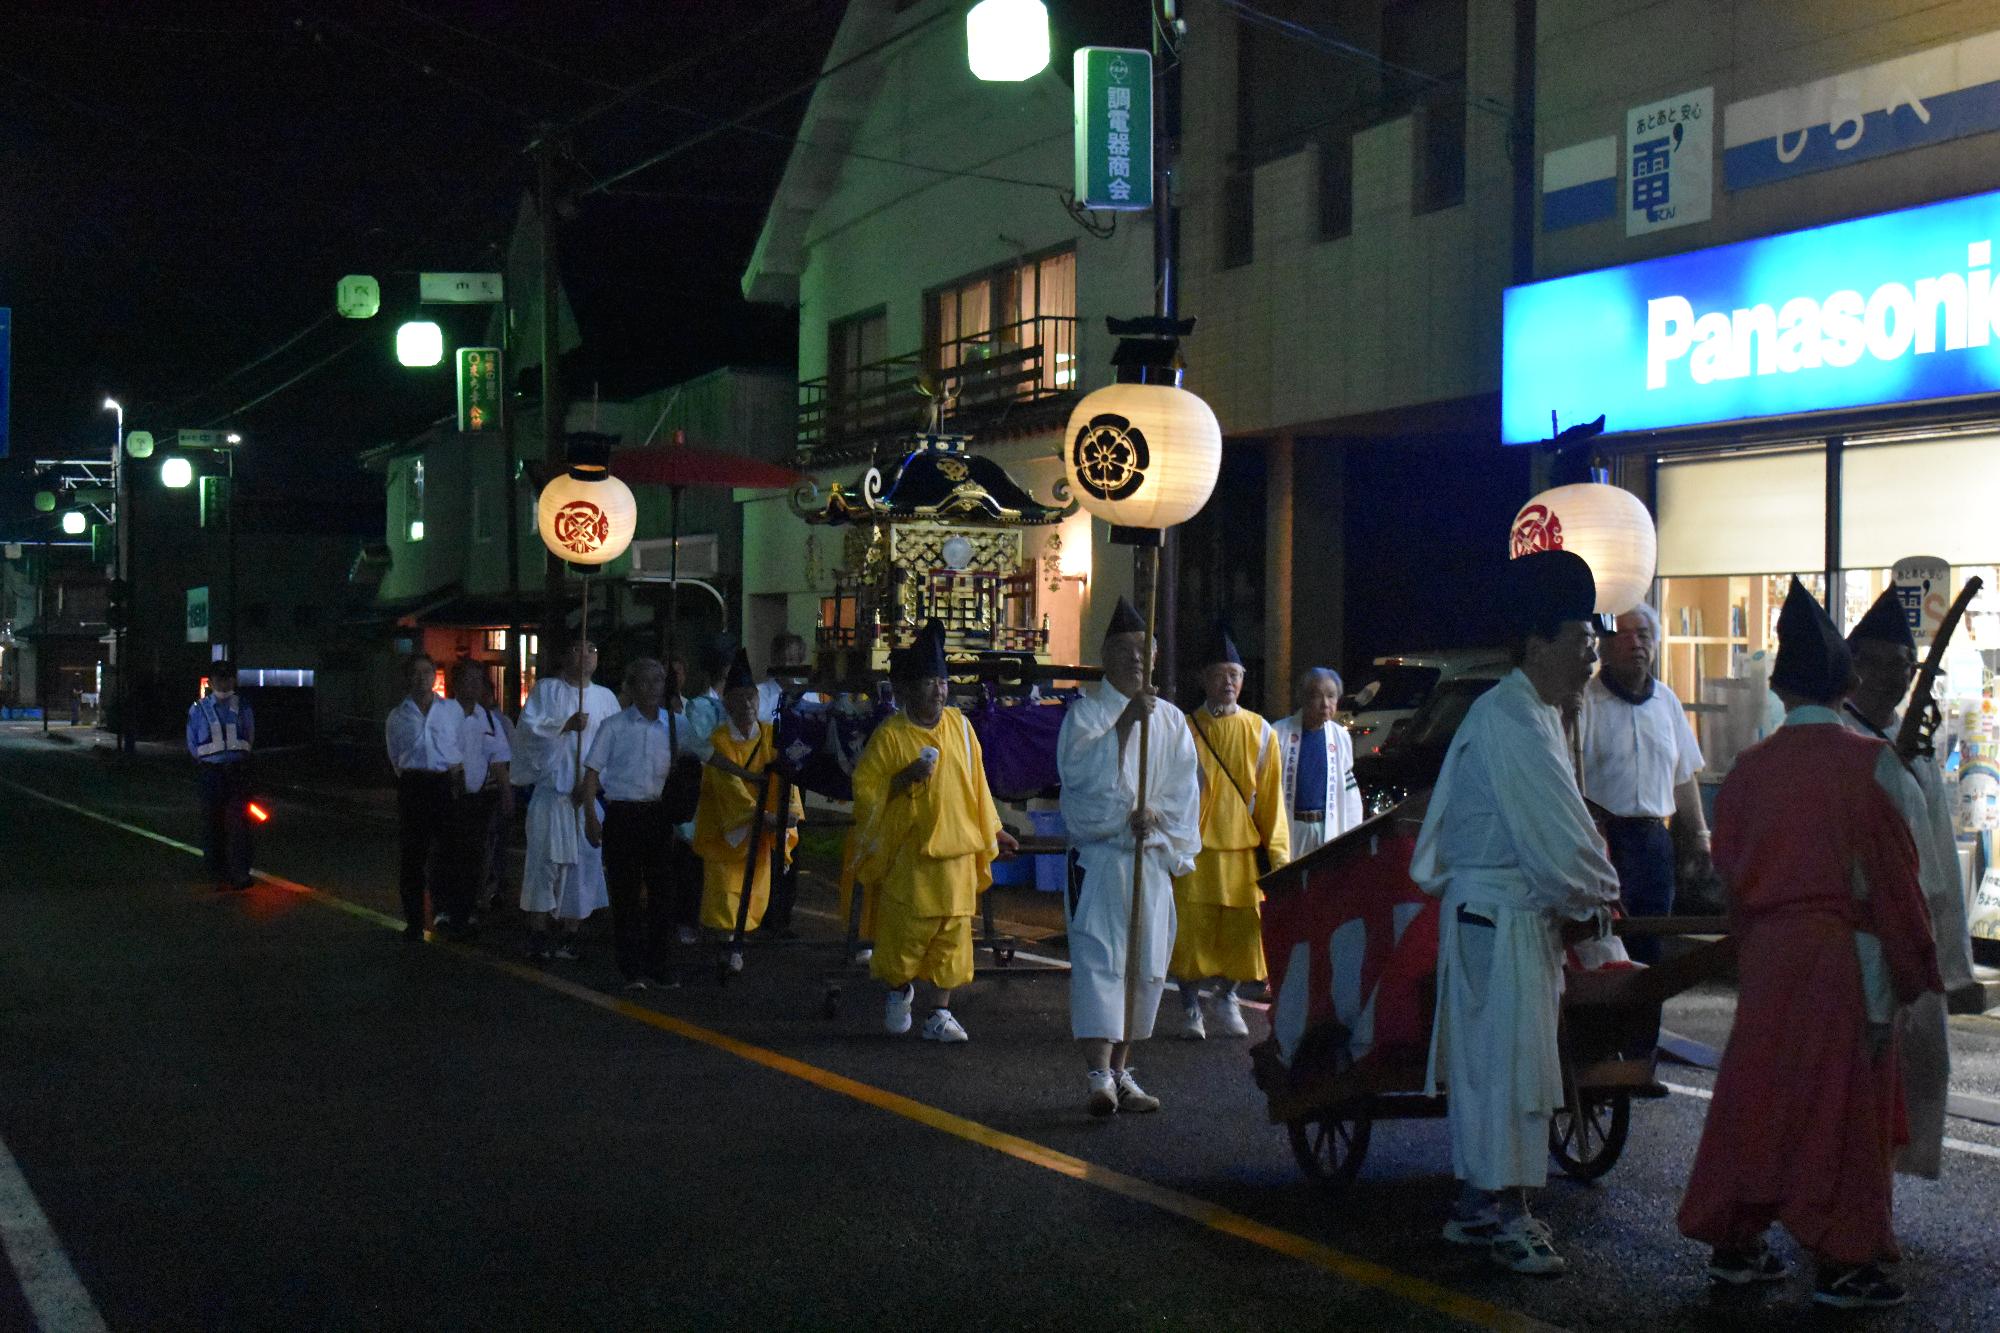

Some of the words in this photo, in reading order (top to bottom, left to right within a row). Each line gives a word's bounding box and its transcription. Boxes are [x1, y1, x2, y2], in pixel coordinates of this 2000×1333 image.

[1107, 86, 1131, 200] 調電器商会
[1646, 239, 2000, 390] Panasoni
